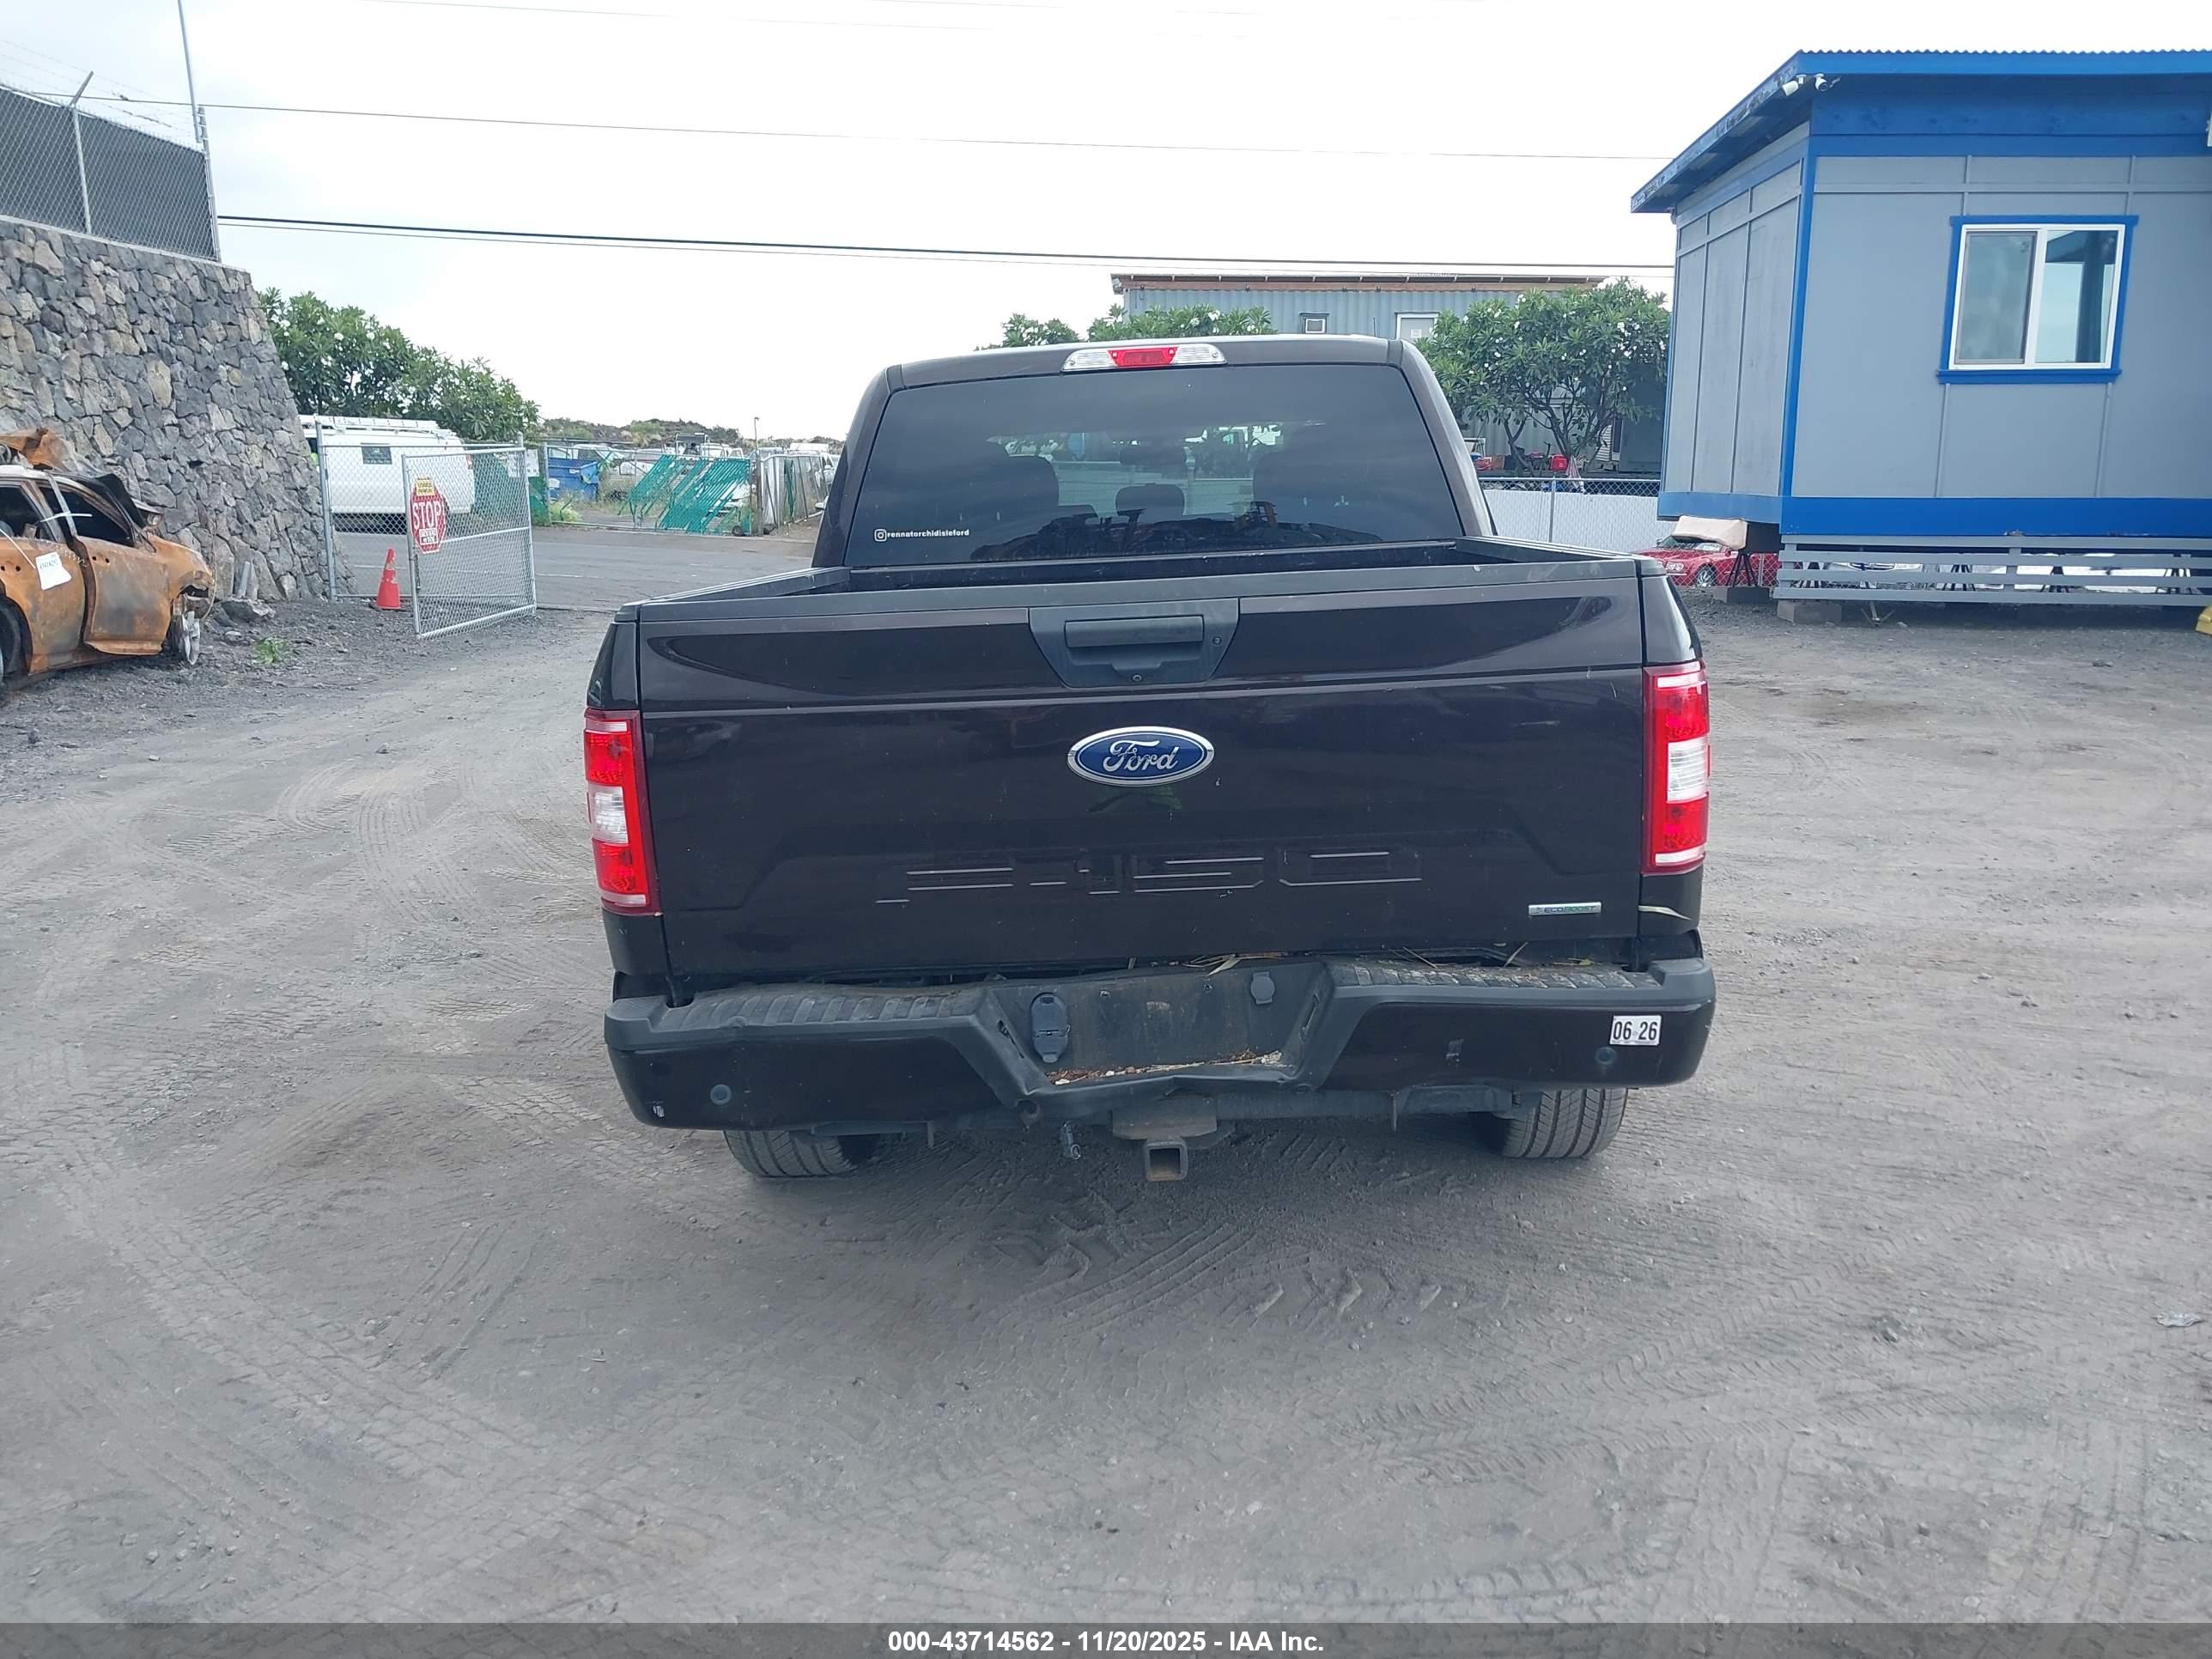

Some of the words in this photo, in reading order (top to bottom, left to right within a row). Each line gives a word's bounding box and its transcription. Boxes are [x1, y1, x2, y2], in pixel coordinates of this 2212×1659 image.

[412, 501, 441, 530] STOP
[1103, 739, 1181, 772] Ford
[1613, 1021, 1632, 1040] 06
[1638, 1021, 1658, 1040] 26
